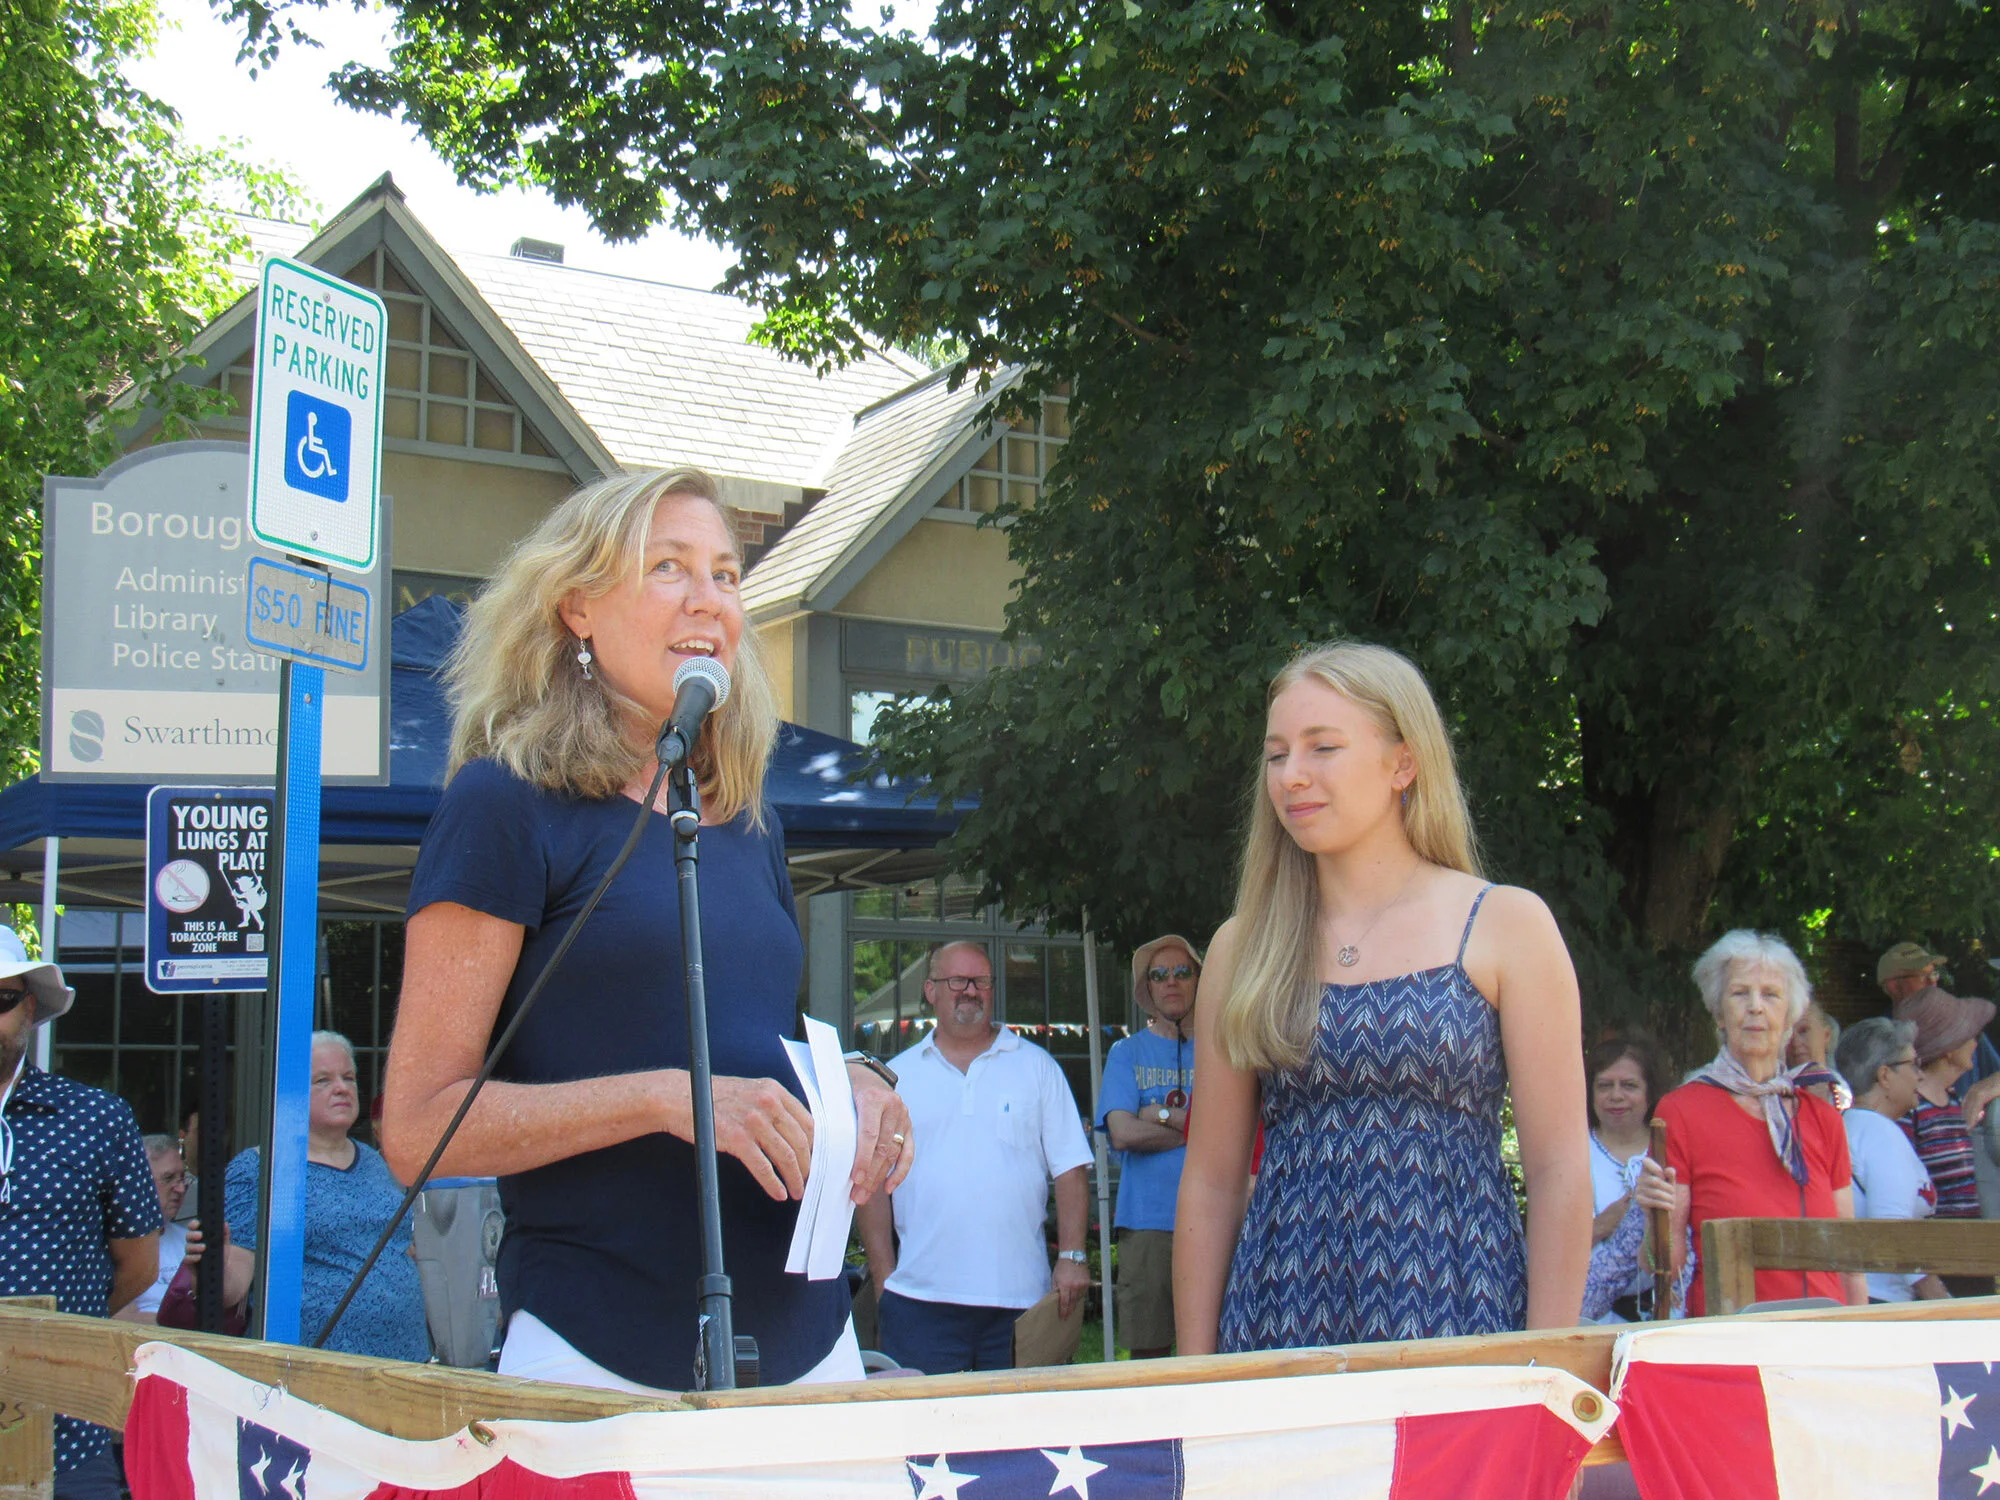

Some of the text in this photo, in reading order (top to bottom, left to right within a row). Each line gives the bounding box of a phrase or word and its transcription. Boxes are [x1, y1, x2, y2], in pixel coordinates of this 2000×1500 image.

[272, 284, 375, 354] RESERVED
[273, 334, 369, 400] PARKING
[91, 502, 250, 550] Boroug
[112, 604, 218, 639] Library
[254, 584, 362, 645] $50 FINE
[112, 643, 280, 673] Police Stati
[172, 805, 268, 830] YOUNG
[178, 831, 268, 850] LUNGS AT
[218, 852, 265, 871] PLAY!
[171, 932, 238, 943] TOBACCO-FREE
[184, 921, 226, 932] THIS IS A
[192, 943, 218, 953] ZONE
